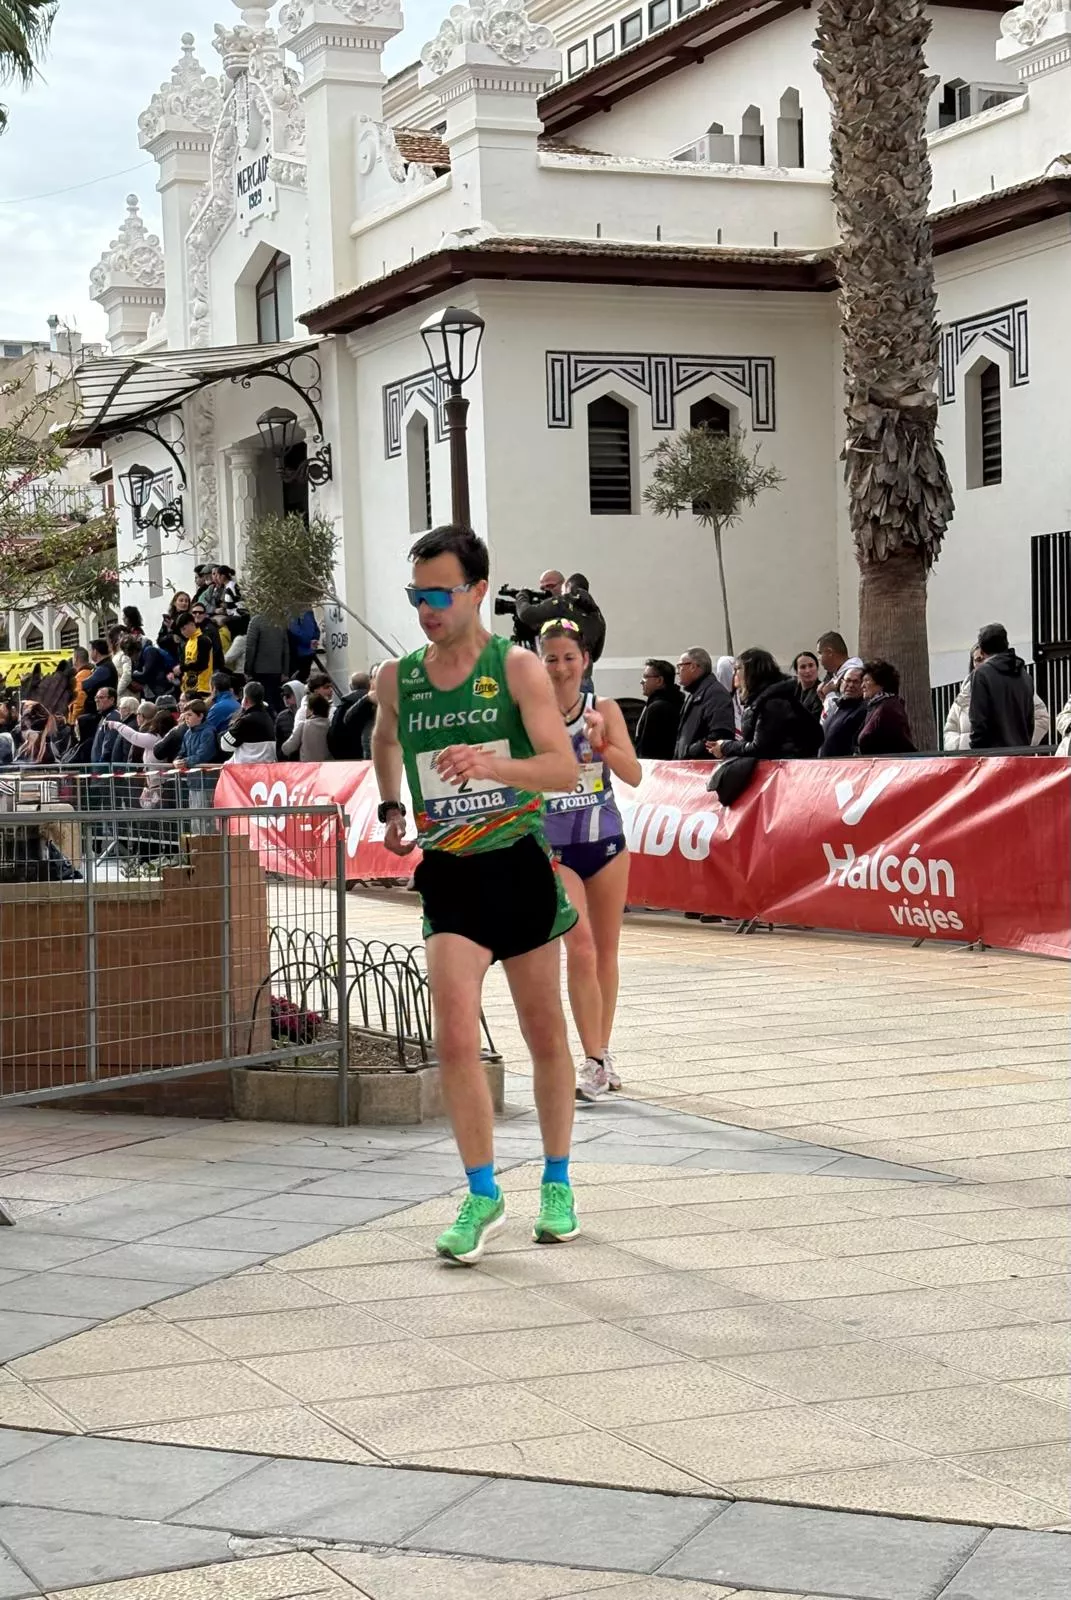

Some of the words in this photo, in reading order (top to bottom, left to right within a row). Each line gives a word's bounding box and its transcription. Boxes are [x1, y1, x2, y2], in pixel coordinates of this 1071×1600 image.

[408, 708, 498, 733] Huesca
[622, 804, 719, 861] NDO
[822, 843, 955, 897] Halcón
[889, 898, 964, 934] viajes
